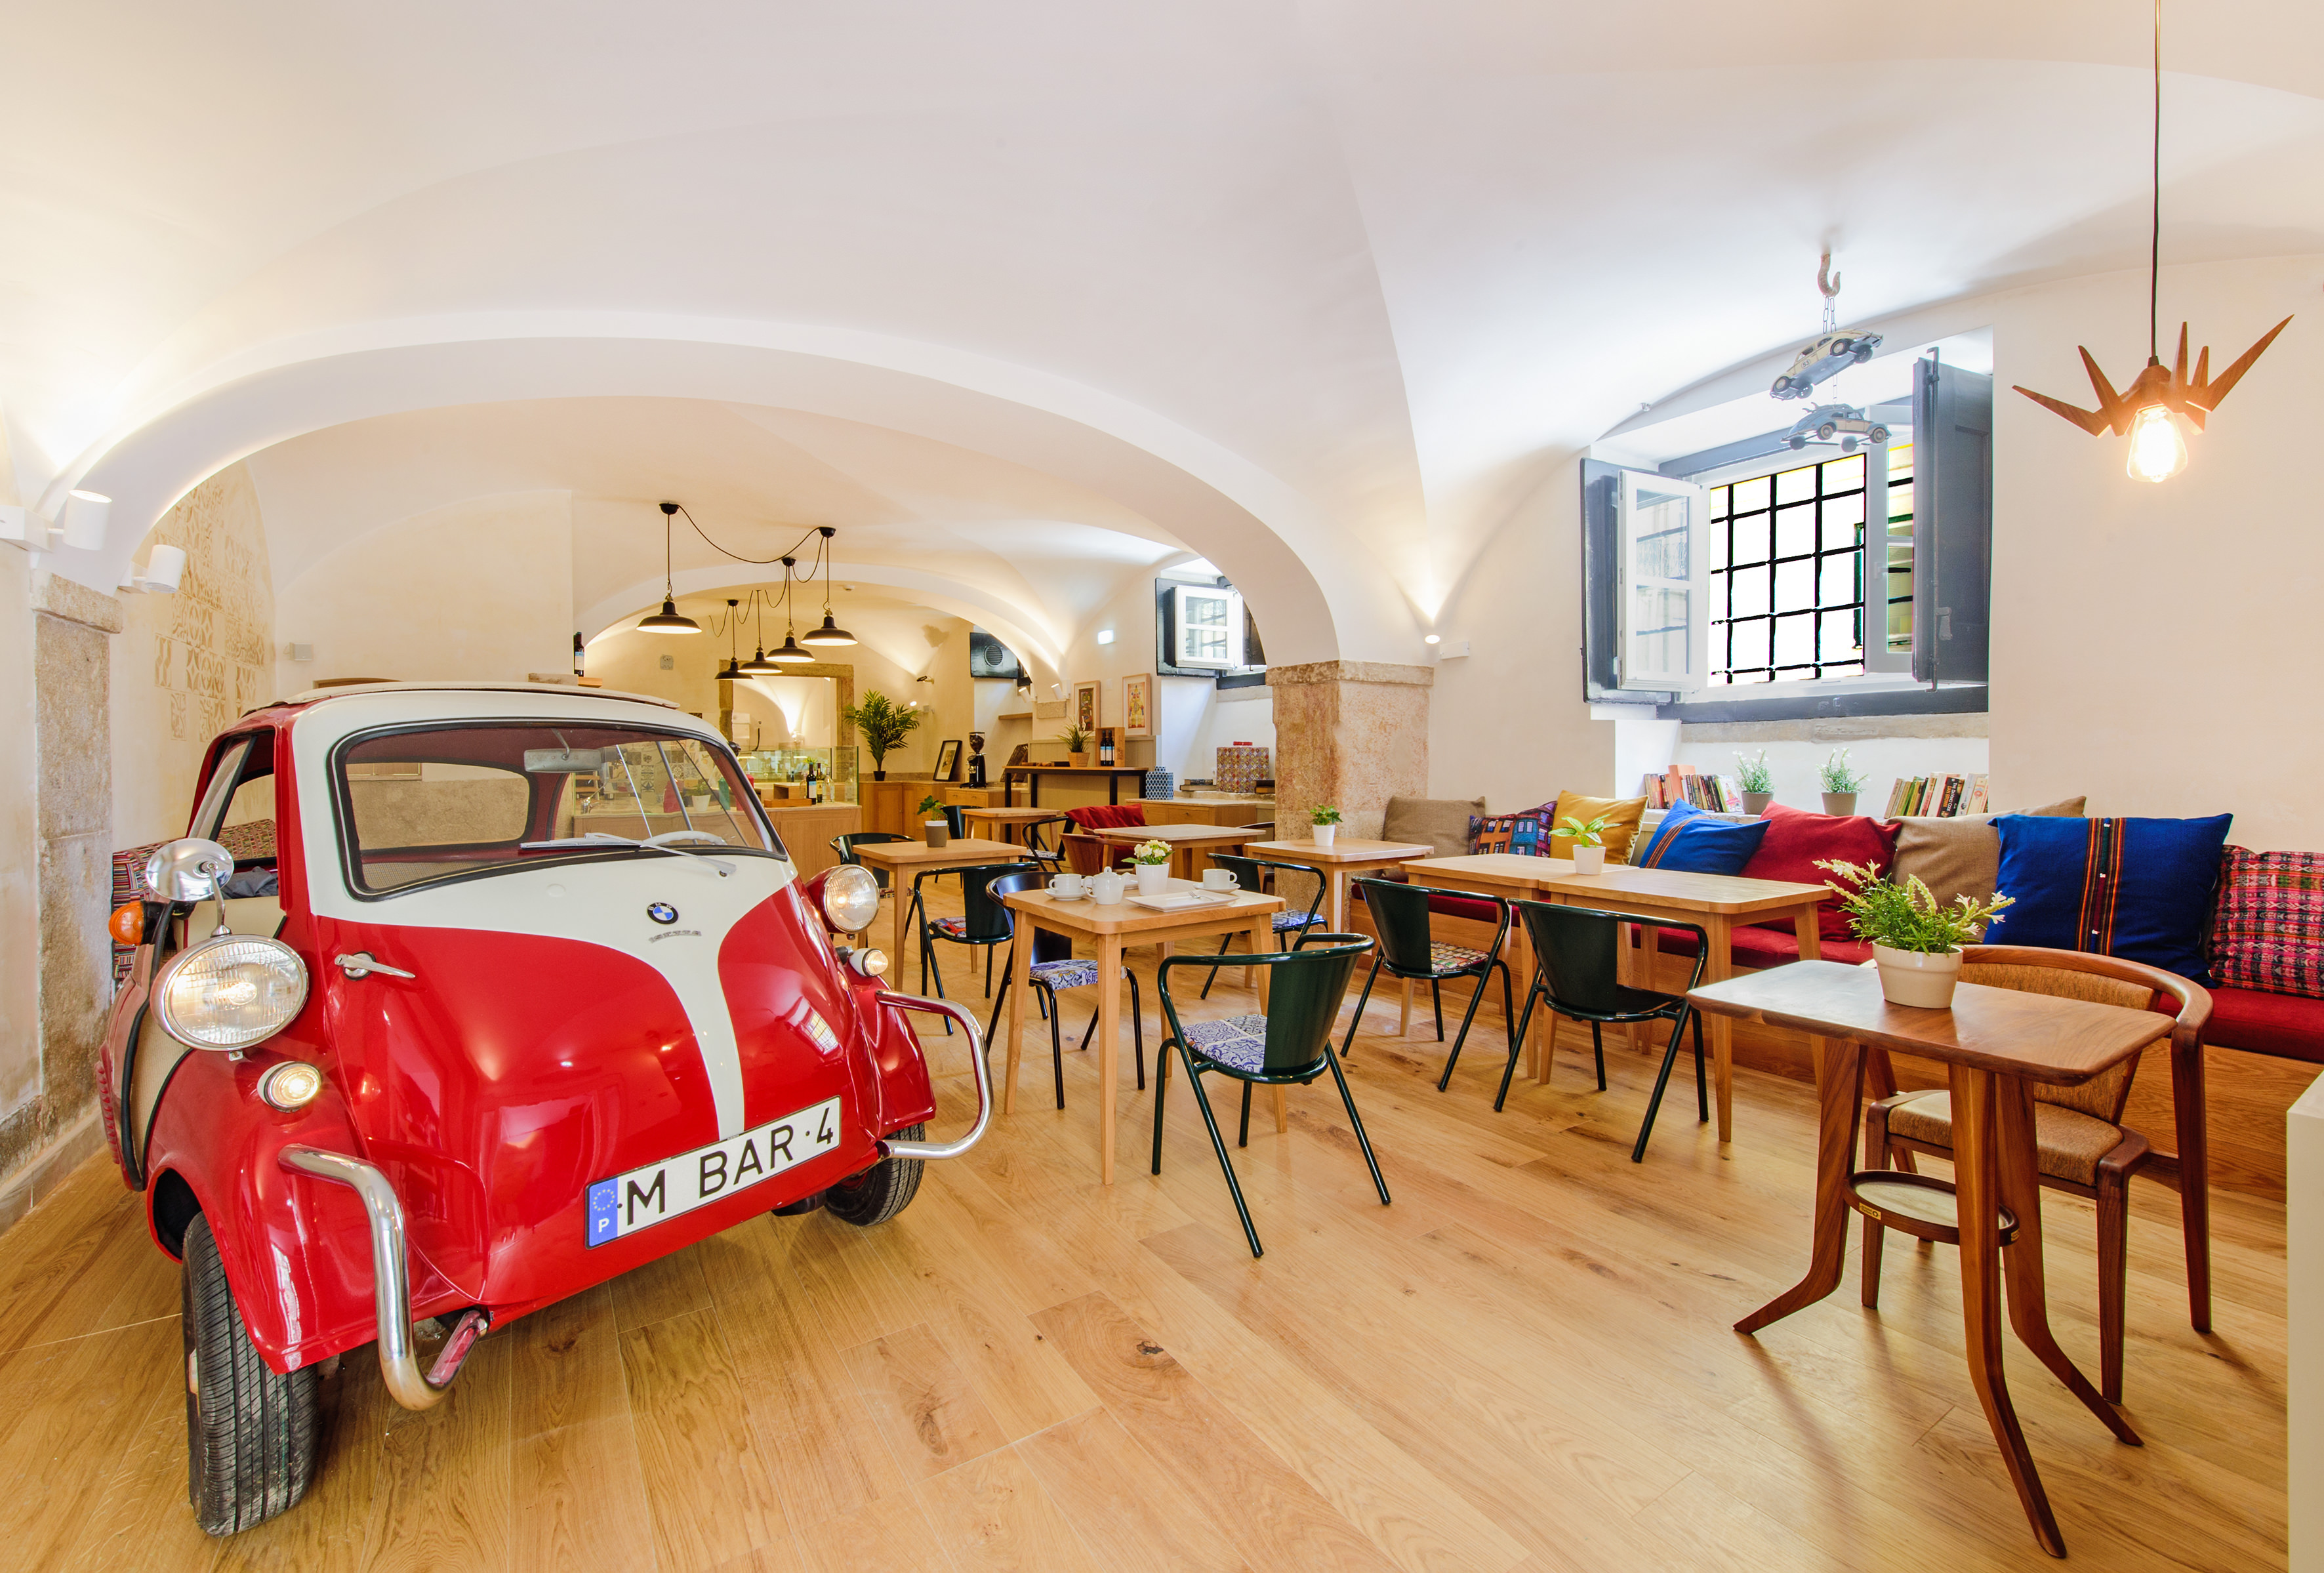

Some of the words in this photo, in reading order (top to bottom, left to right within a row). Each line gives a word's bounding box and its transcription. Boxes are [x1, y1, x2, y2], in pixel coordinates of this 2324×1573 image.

[647, 902, 673, 911] BMW
[627, 1168, 666, 1225] M
[699, 1124, 794, 1199] BAR
[817, 1107, 834, 1145] 4
[598, 1217, 609, 1233] P
